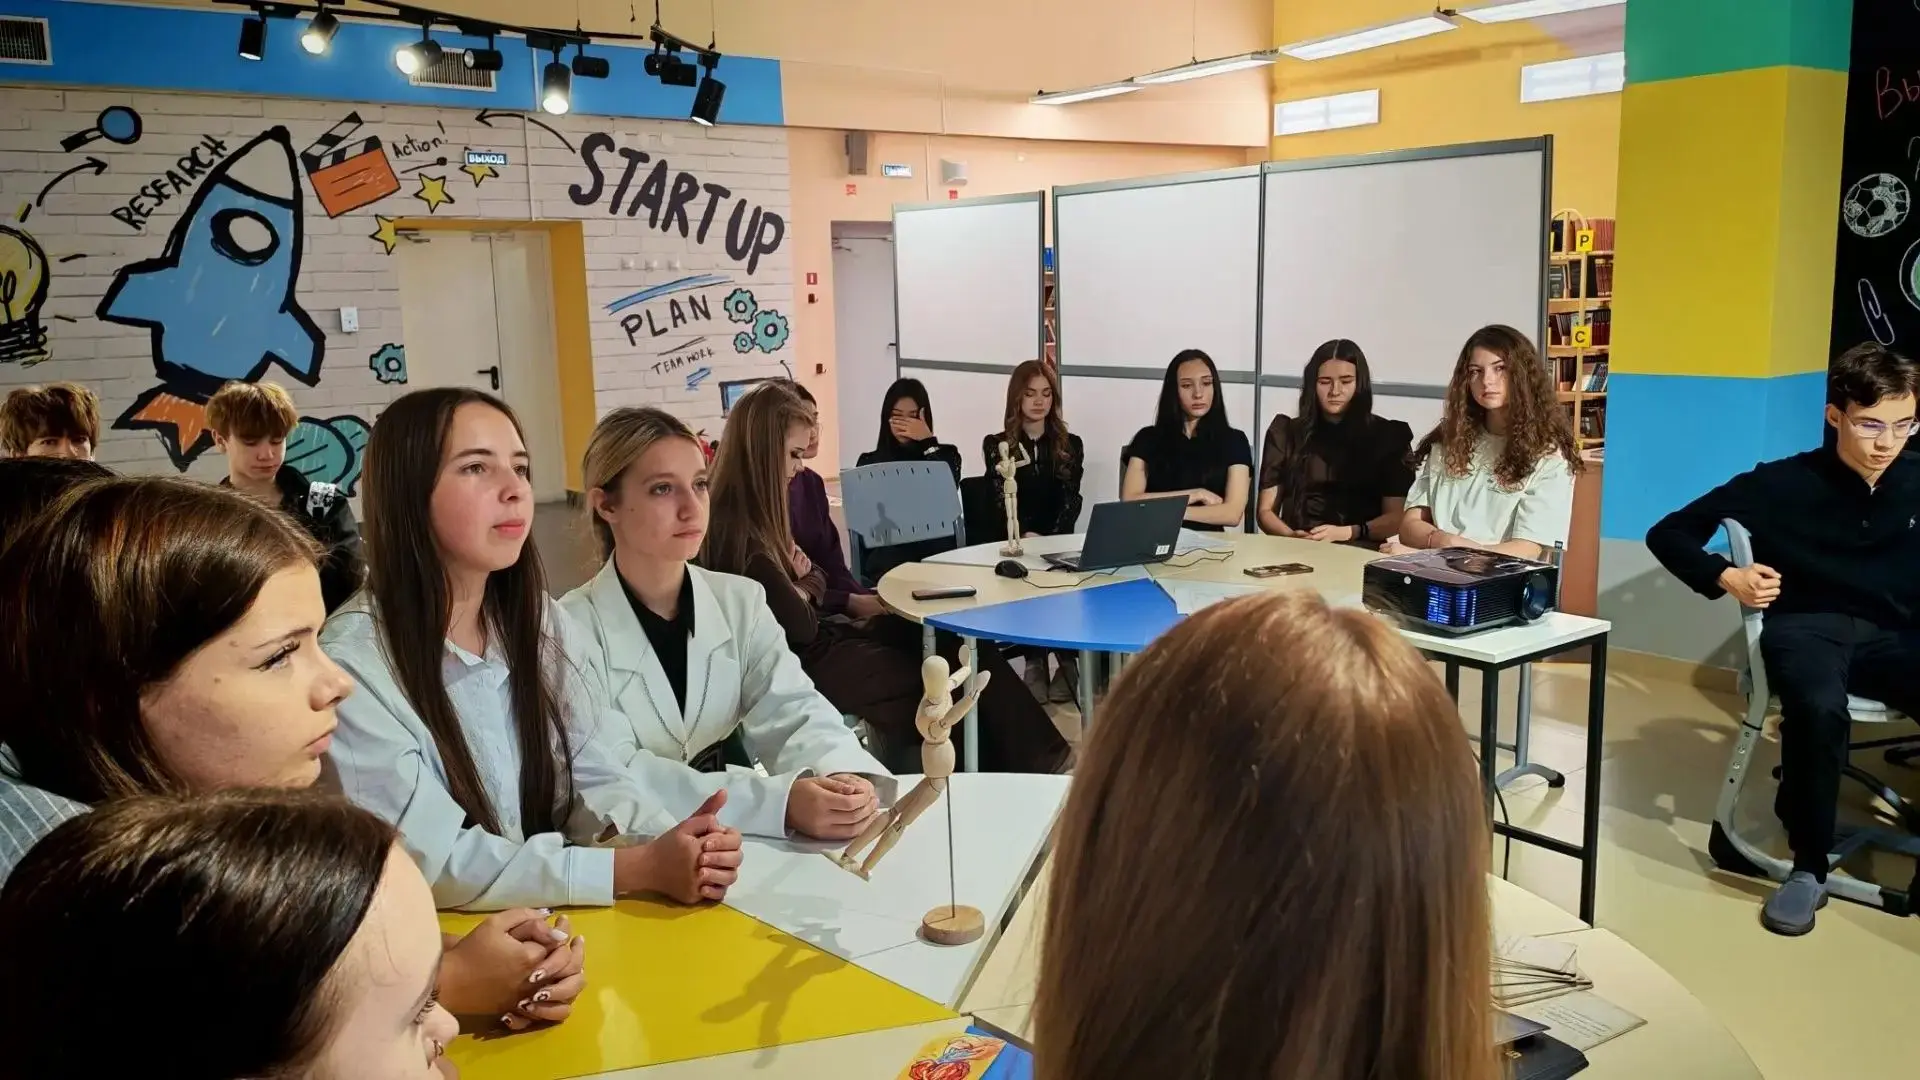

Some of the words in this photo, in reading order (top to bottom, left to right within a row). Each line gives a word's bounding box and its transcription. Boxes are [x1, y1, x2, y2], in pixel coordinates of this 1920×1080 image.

[392, 120, 448, 158] Action!
[468, 153, 505, 165] ВЫХОД
[110, 134, 227, 231] RESEARCH
[620, 294, 712, 347] PLAN
[651, 356, 684, 375] TEAM
[686, 347, 714, 364] WORK
